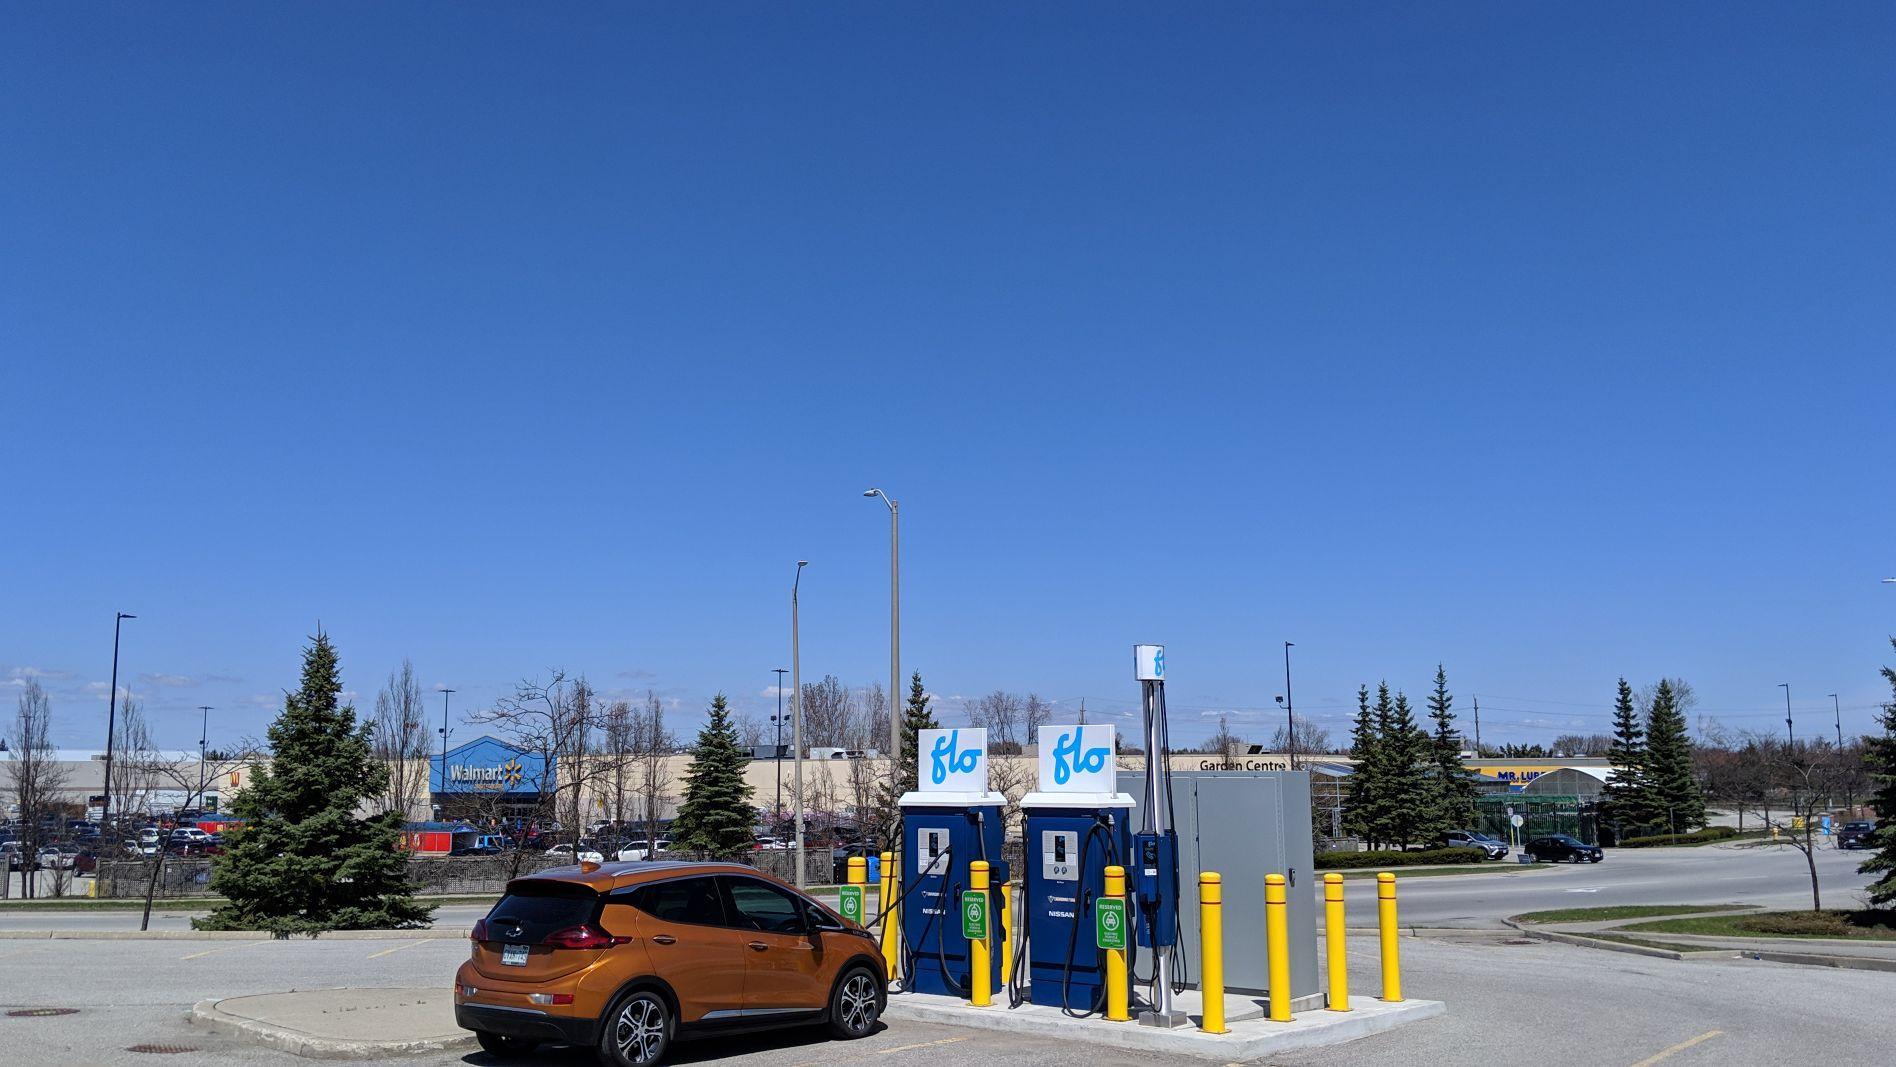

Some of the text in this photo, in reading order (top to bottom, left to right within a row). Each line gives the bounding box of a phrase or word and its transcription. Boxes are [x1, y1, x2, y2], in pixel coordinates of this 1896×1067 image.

[931, 729, 983, 785] flo
[1053, 726, 1110, 785] flo
[450, 764, 503, 781] Walmart
[1200, 760, 1286, 771] Garden Centre
[1498, 771, 1547, 781] MR. LUB
[1048, 910, 1075, 918] NISSAN
